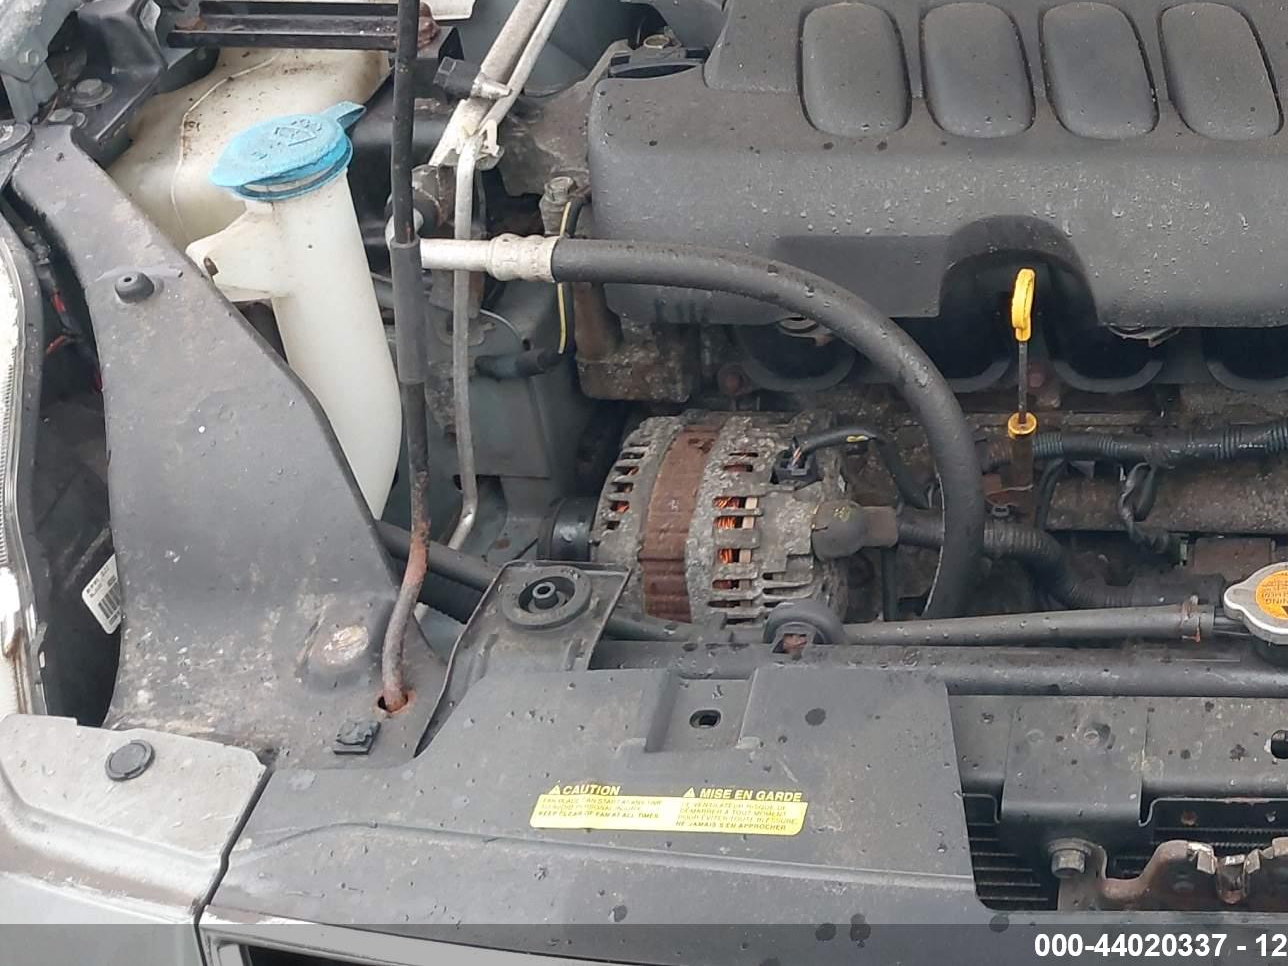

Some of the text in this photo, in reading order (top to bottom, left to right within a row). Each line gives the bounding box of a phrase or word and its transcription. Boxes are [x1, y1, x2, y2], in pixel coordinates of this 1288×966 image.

[562, 784, 621, 795] CAUTION
[700, 788, 803, 803] MISE EN GARDE
